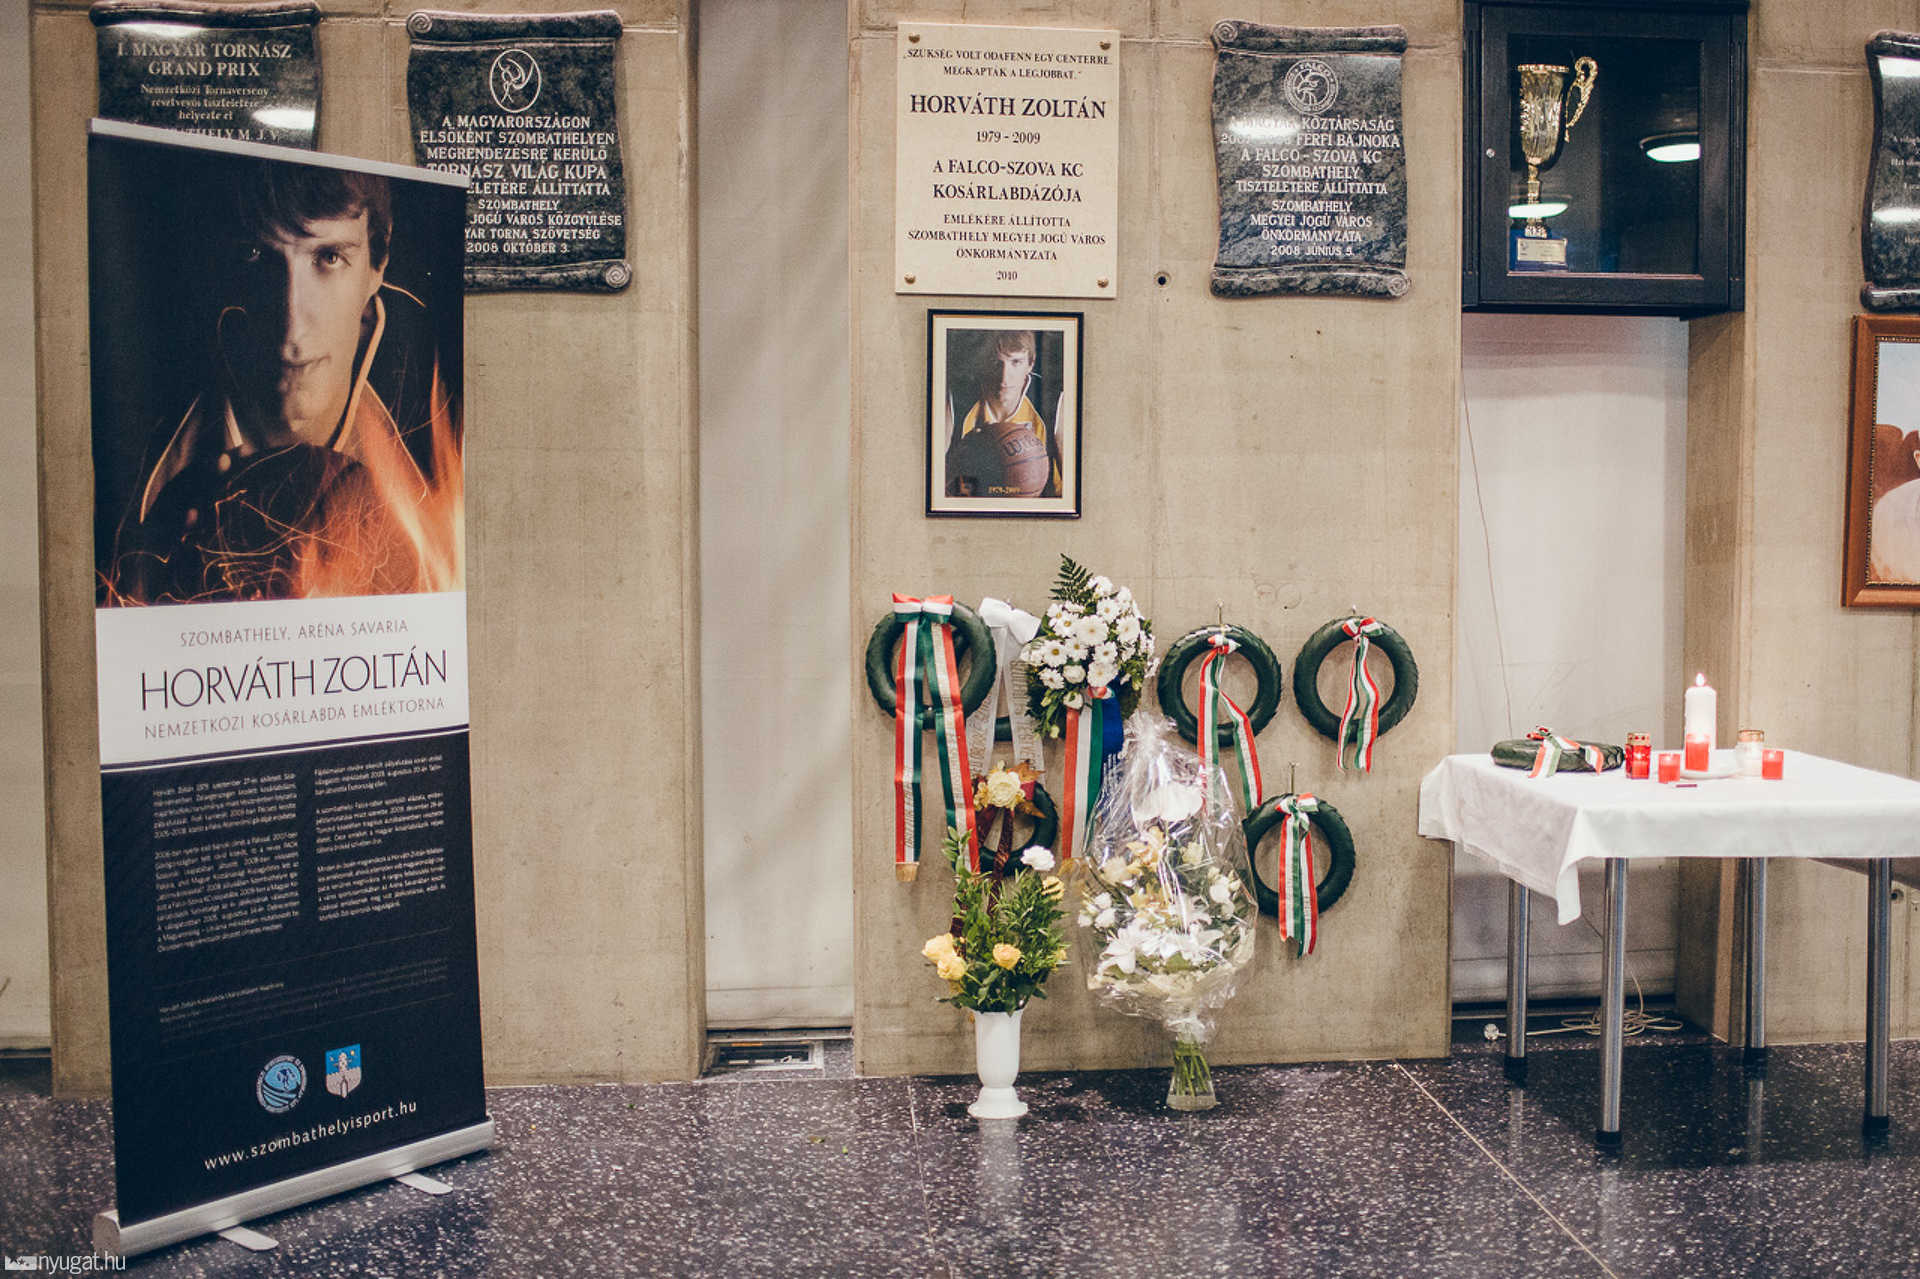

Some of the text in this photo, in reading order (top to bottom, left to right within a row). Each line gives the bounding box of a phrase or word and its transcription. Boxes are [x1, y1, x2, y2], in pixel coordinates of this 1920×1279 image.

[132, 42, 206, 57] MAGYAR
[211, 41, 292, 58] TORNÁSZ
[956, 50, 981, 60] VOLT
[984, 51, 1031, 62] ODAFENN
[1034, 53, 1054, 64] EGY
[148, 61, 260, 76] GRAND PRIX
[1011, 67, 1017, 78] A
[910, 92, 1106, 118] HORVÁTH ZOLTÁN
[442, 112, 591, 129] A MAGYARORSZÁGON
[1302, 115, 1395, 132] KÖZTÁRSASÁG
[499, 131, 615, 145] SZOMBATHELYEN
[976, 131, 1001, 144] 1979
[1012, 131, 1040, 144] 2009
[1297, 132, 1332, 147] FÉRFI
[1337, 134, 1401, 148] BAJNOKA
[427, 144, 607, 160] MEGRENDEZÉSRE KERÜLŐ
[1241, 149, 1251, 161] A
[1256, 149, 1300, 161] FALCO
[1313, 150, 1358, 163] SZOVA
[1363, 151, 1382, 164] KC
[511, 160, 559, 179] VILÁG
[564, 164, 607, 179] KUPA
[933, 159, 1084, 177] A FALCO-SZOVA KC
[1262, 164, 1360, 179] SZOMBATHELY
[532, 180, 611, 195] ÁLLÍTTATTA
[933, 182, 1082, 203] KOSÁRLABDÁZÓJA
[1236, 178, 1388, 194] TISZTELETÉRE ÁLLÍTTATTA
[478, 199, 560, 211] SZOMBATHELY
[1271, 200, 1352, 212] SZOMBATHELY
[470, 211, 502, 224] JOGÚ
[506, 211, 544, 225] VÁROS
[944, 213, 1005, 226] EMLÉKÉRE
[1250, 213, 1373, 228] MEGYEI JOGÚ VÁROS
[490, 227, 528, 240] TORNA
[533, 225, 600, 240] SZÖVETSÉG
[908, 230, 1106, 245] SZOMBATHELY MEGYEI JOGÚ VÁROS
[1261, 227, 1362, 241] ÖNKORMÁNYZATA
[466, 243, 498, 253] 2008
[503, 240, 556, 253] OKTÓBER
[956, 247, 1057, 261] ÖNKORMÁNYZATA
[1271, 245, 1300, 256] 2008
[1305, 242, 1342, 256] JÚNIUS
[995, 270, 1018, 281] 2010
[298, 622, 345, 640] ARÉNA
[351, 619, 409, 637] SAVARIA
[141, 645, 447, 711] HORVÁTH ZOLTÁN
[252, 705, 347, 729] KOSÁRLABDA
[353, 697, 446, 719] EMLÉKTORNA
[204, 1101, 417, 1170] www.szombathelyisport.hu
